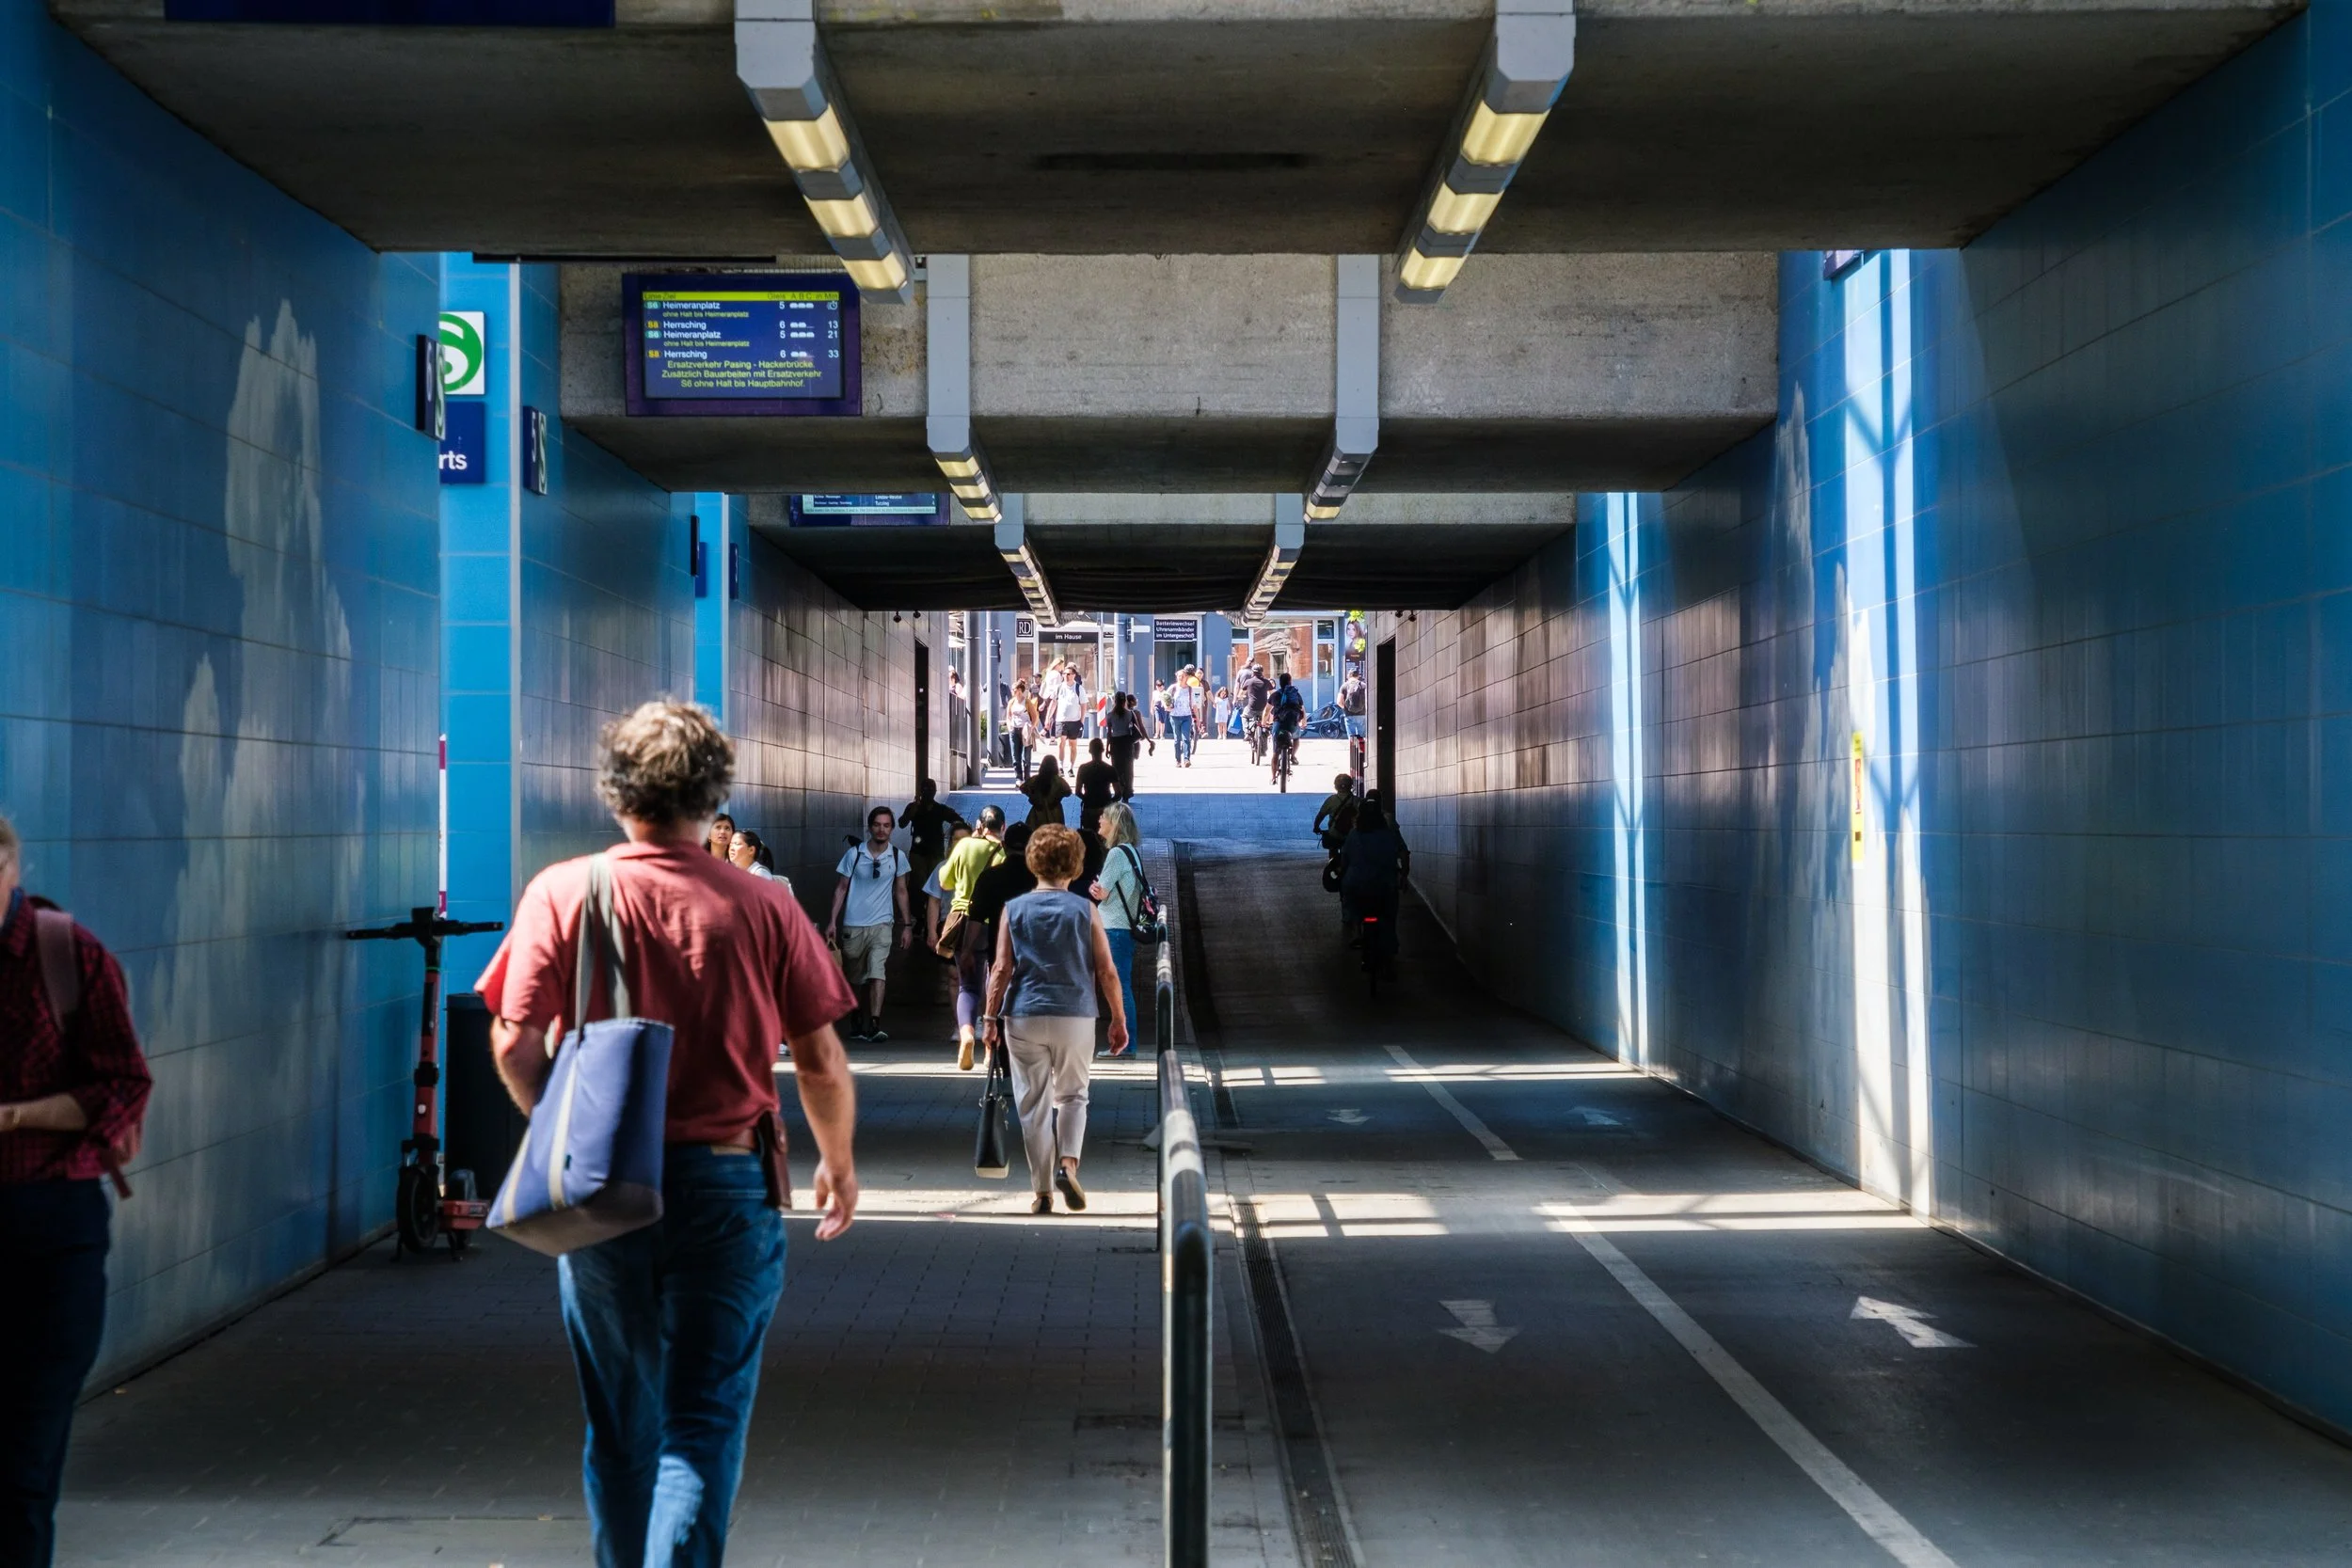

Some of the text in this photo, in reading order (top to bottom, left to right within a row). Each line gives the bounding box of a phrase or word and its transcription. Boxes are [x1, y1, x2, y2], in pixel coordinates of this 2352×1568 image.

[663, 302, 721, 310] Heimeranplatz
[663, 321, 707, 330] Herrsching
[663, 330, 721, 339] Heimeranplatz
[664, 350, 707, 359] Herrsching
[667, 360, 722, 369] Ersatzverkehr
[724, 360, 751, 370] Pasing
[681, 379, 805, 388] S6 ohne Halt bis Hauptbahnhof.
[1019, 621, 1031, 635] RD
